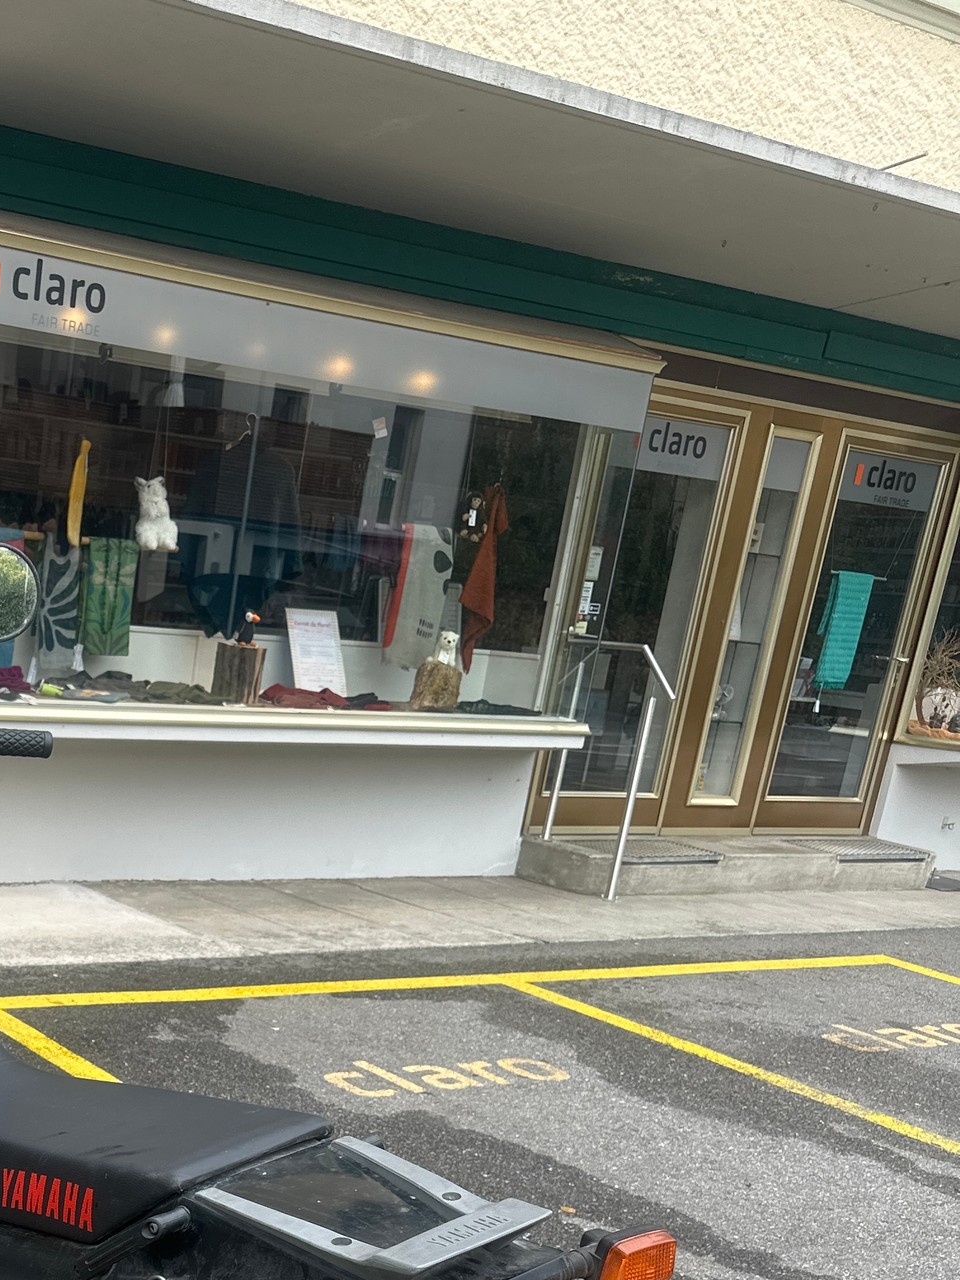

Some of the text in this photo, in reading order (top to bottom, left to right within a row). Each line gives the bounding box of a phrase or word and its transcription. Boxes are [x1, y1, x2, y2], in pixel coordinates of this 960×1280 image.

[12, 258, 106, 314] claro
[31, 312, 101, 337] FAIR TRADE
[648, 421, 707, 459] claro
[867, 459, 917, 494] claro
[873, 494, 910, 508] FAIR TRADE
[323, 1058, 571, 1098] claro
[1, 1168, 94, 1233] YAMAHA
